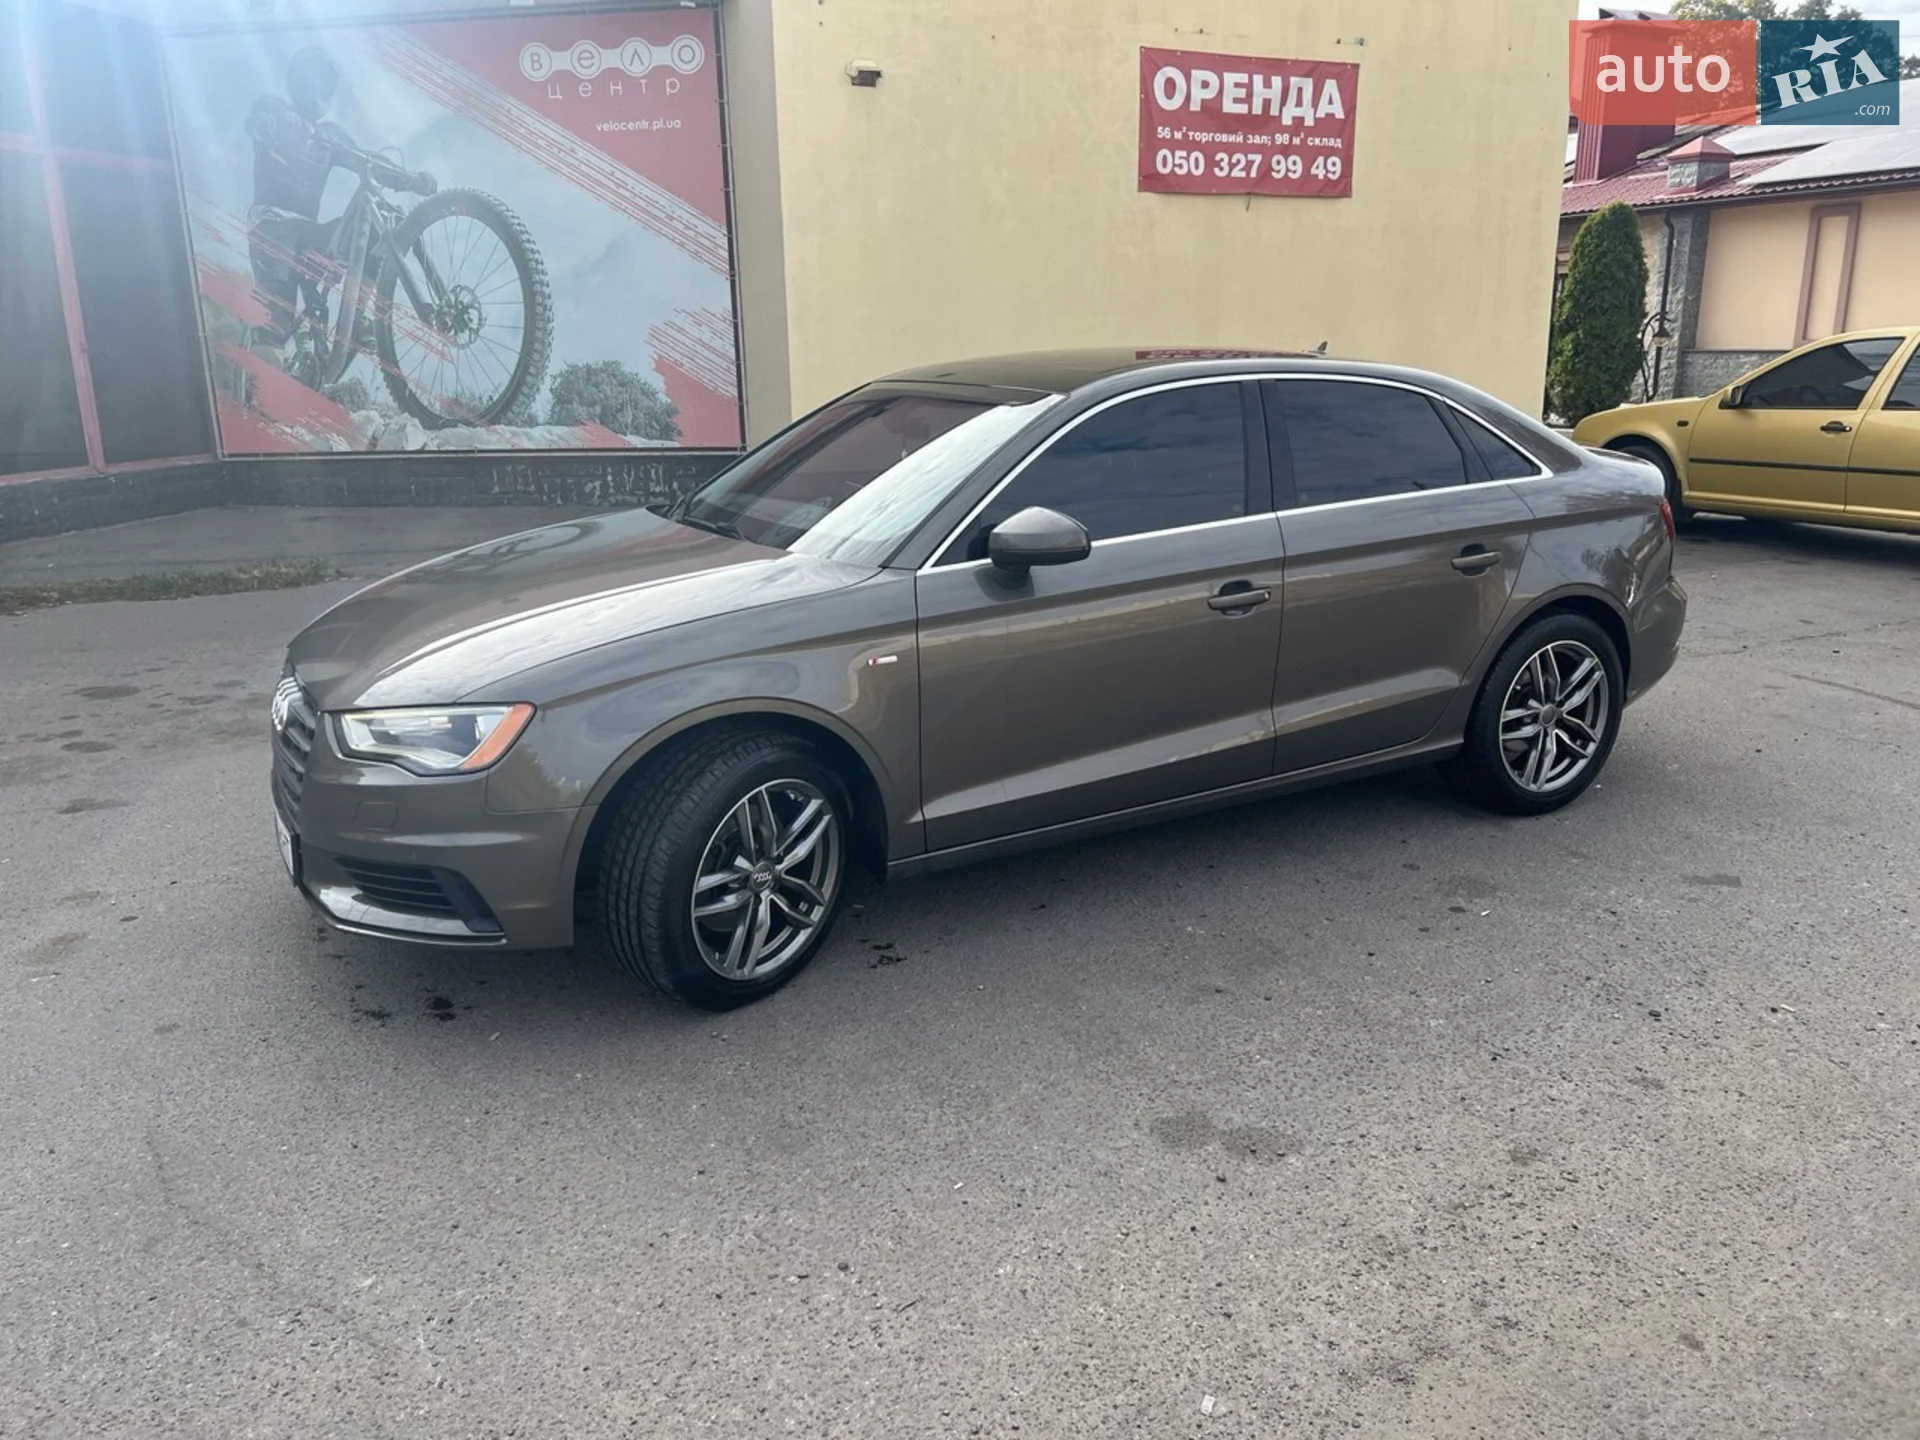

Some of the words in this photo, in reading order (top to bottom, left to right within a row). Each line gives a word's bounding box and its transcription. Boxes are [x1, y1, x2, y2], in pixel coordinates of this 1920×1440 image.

[548, 77, 681, 100] центр
[1153, 66, 1345, 127] ОРЕНДА
[595, 118, 682, 132] velocentr.pl.ua
[1157, 126, 1171, 139] 56
[1188, 131, 1244, 143] торговий
[1274, 133, 1290, 145] 98
[1307, 136, 1342, 148] склад
[1156, 149, 1205, 176] 050
[1213, 152, 1262, 178] 327
[1271, 154, 1303, 180] 99
[1310, 156, 1342, 180] 49
